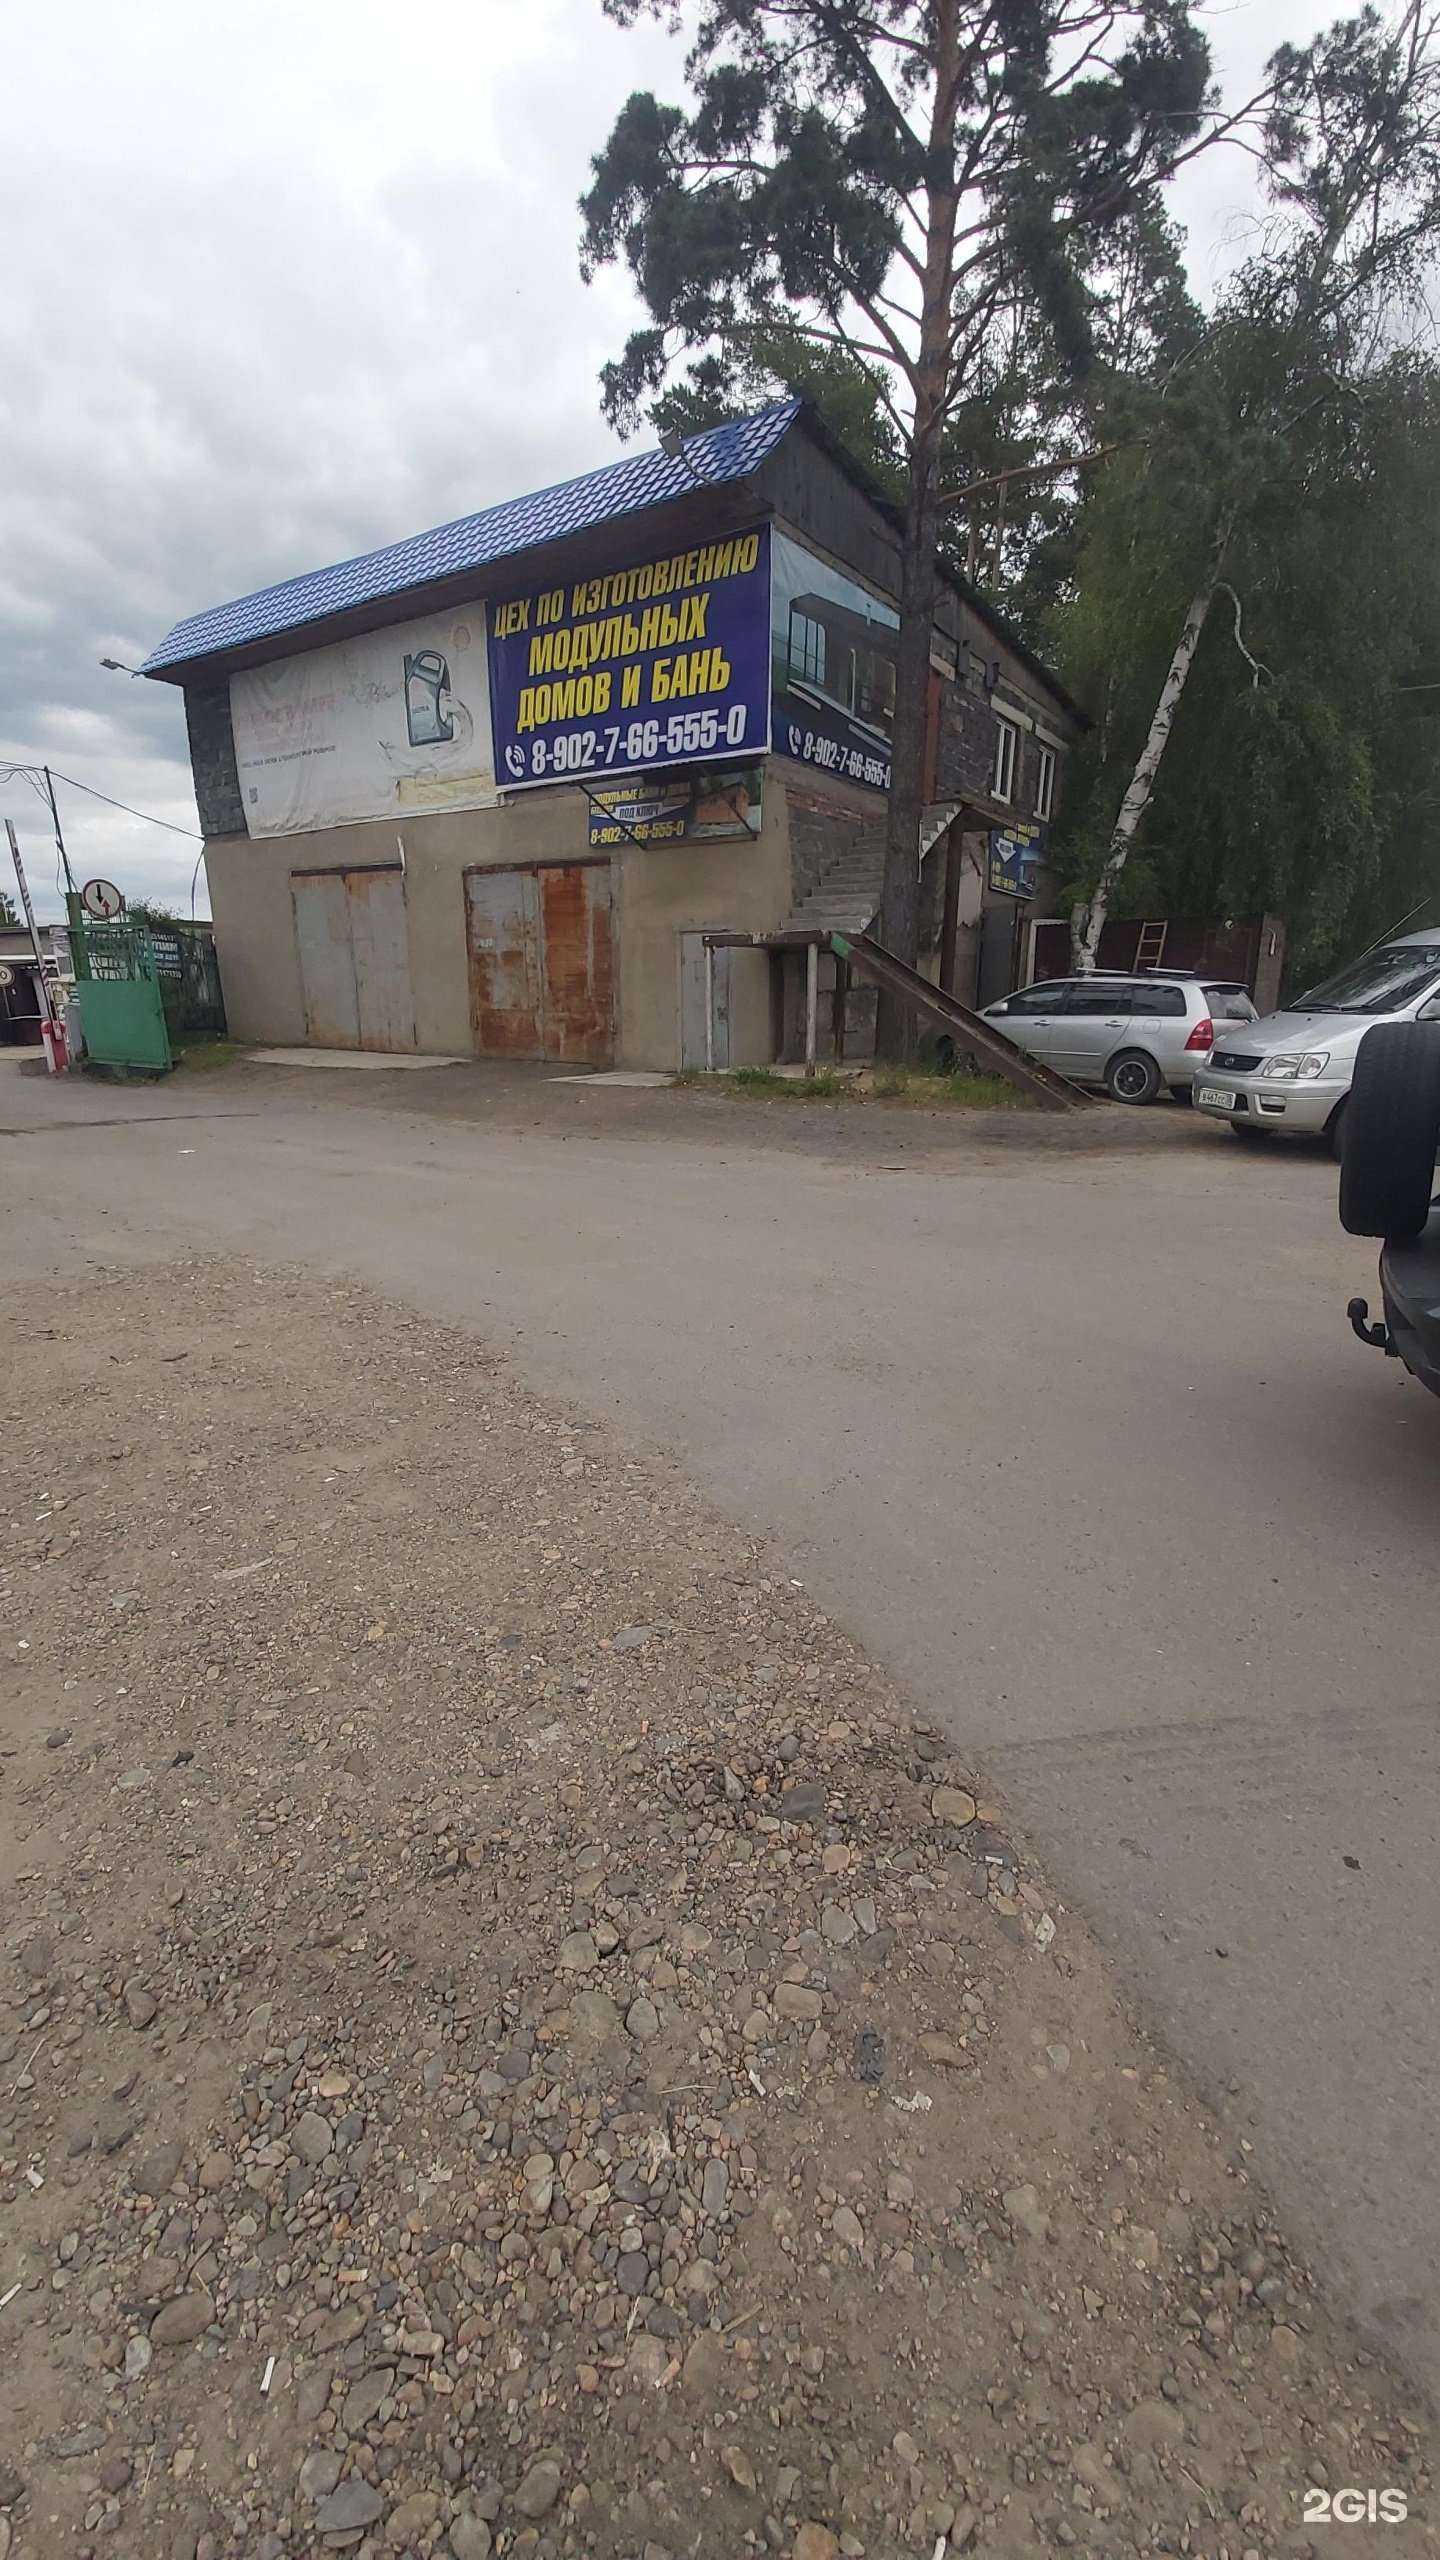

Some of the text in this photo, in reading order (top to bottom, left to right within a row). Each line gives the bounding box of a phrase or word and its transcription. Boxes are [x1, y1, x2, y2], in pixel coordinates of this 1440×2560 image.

[494, 533, 759, 640] ЦЕХ ПО ИЗГОТОВЛЕНИЮ
[528, 592, 710, 676] МОДУЛЬНЫХ
[516, 646, 731, 734] ДОМОВ И БАНЬ
[531, 704, 747, 775] 8-902-7-66-555-0
[803, 731, 891, 789] 8-902-7-66-555-0
